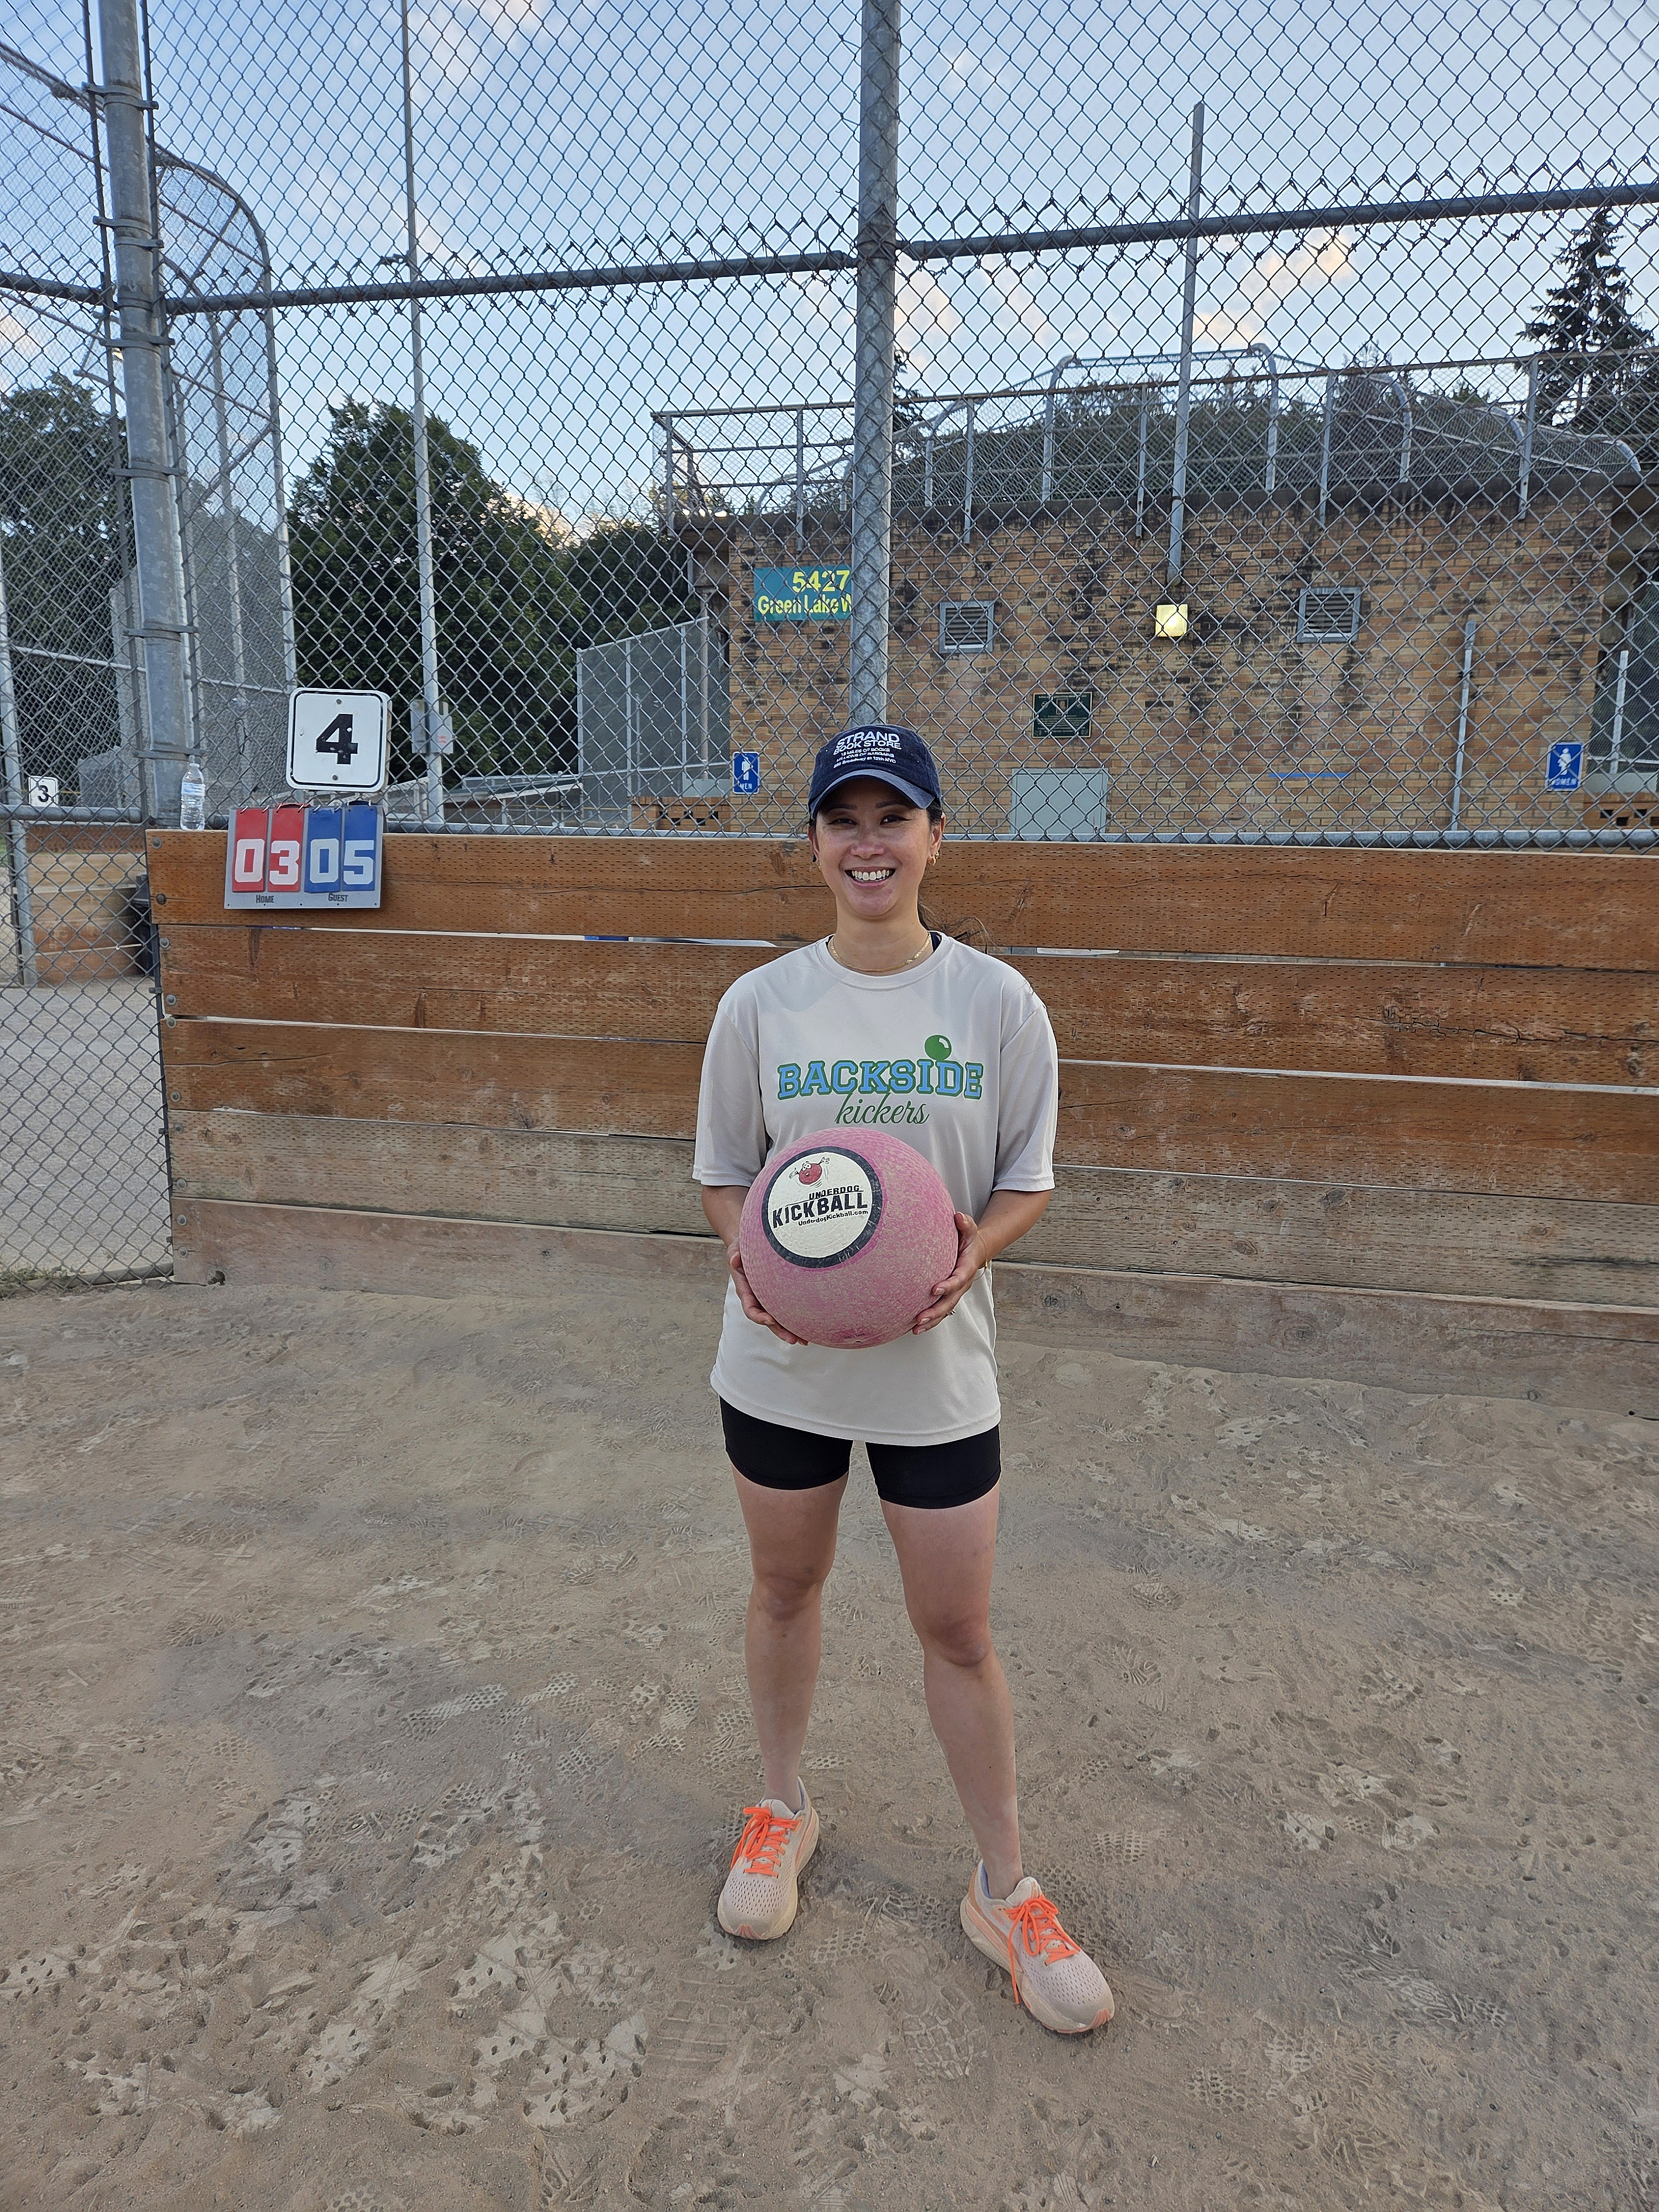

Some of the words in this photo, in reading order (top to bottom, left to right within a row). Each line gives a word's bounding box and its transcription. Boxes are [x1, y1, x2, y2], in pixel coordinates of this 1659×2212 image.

[792, 570, 851, 593] 5427
[758, 595, 802, 614] Green
[804, 594, 839, 614] Lake
[315, 713, 358, 765] 4
[833, 741, 862, 755] BOOK
[863, 740, 902, 750] STORE
[836, 731, 900, 749] STRAND
[37, 785, 49, 802] 3
[255, 894, 275, 904] HOME
[328, 893, 348, 902] GUEST
[777, 1058, 984, 1100] BACKSIDE
[834, 1092, 930, 1125] kickers
[808, 1185, 860, 1201] UNDERDOG
[773, 1192, 868, 1229] KICKBALL
